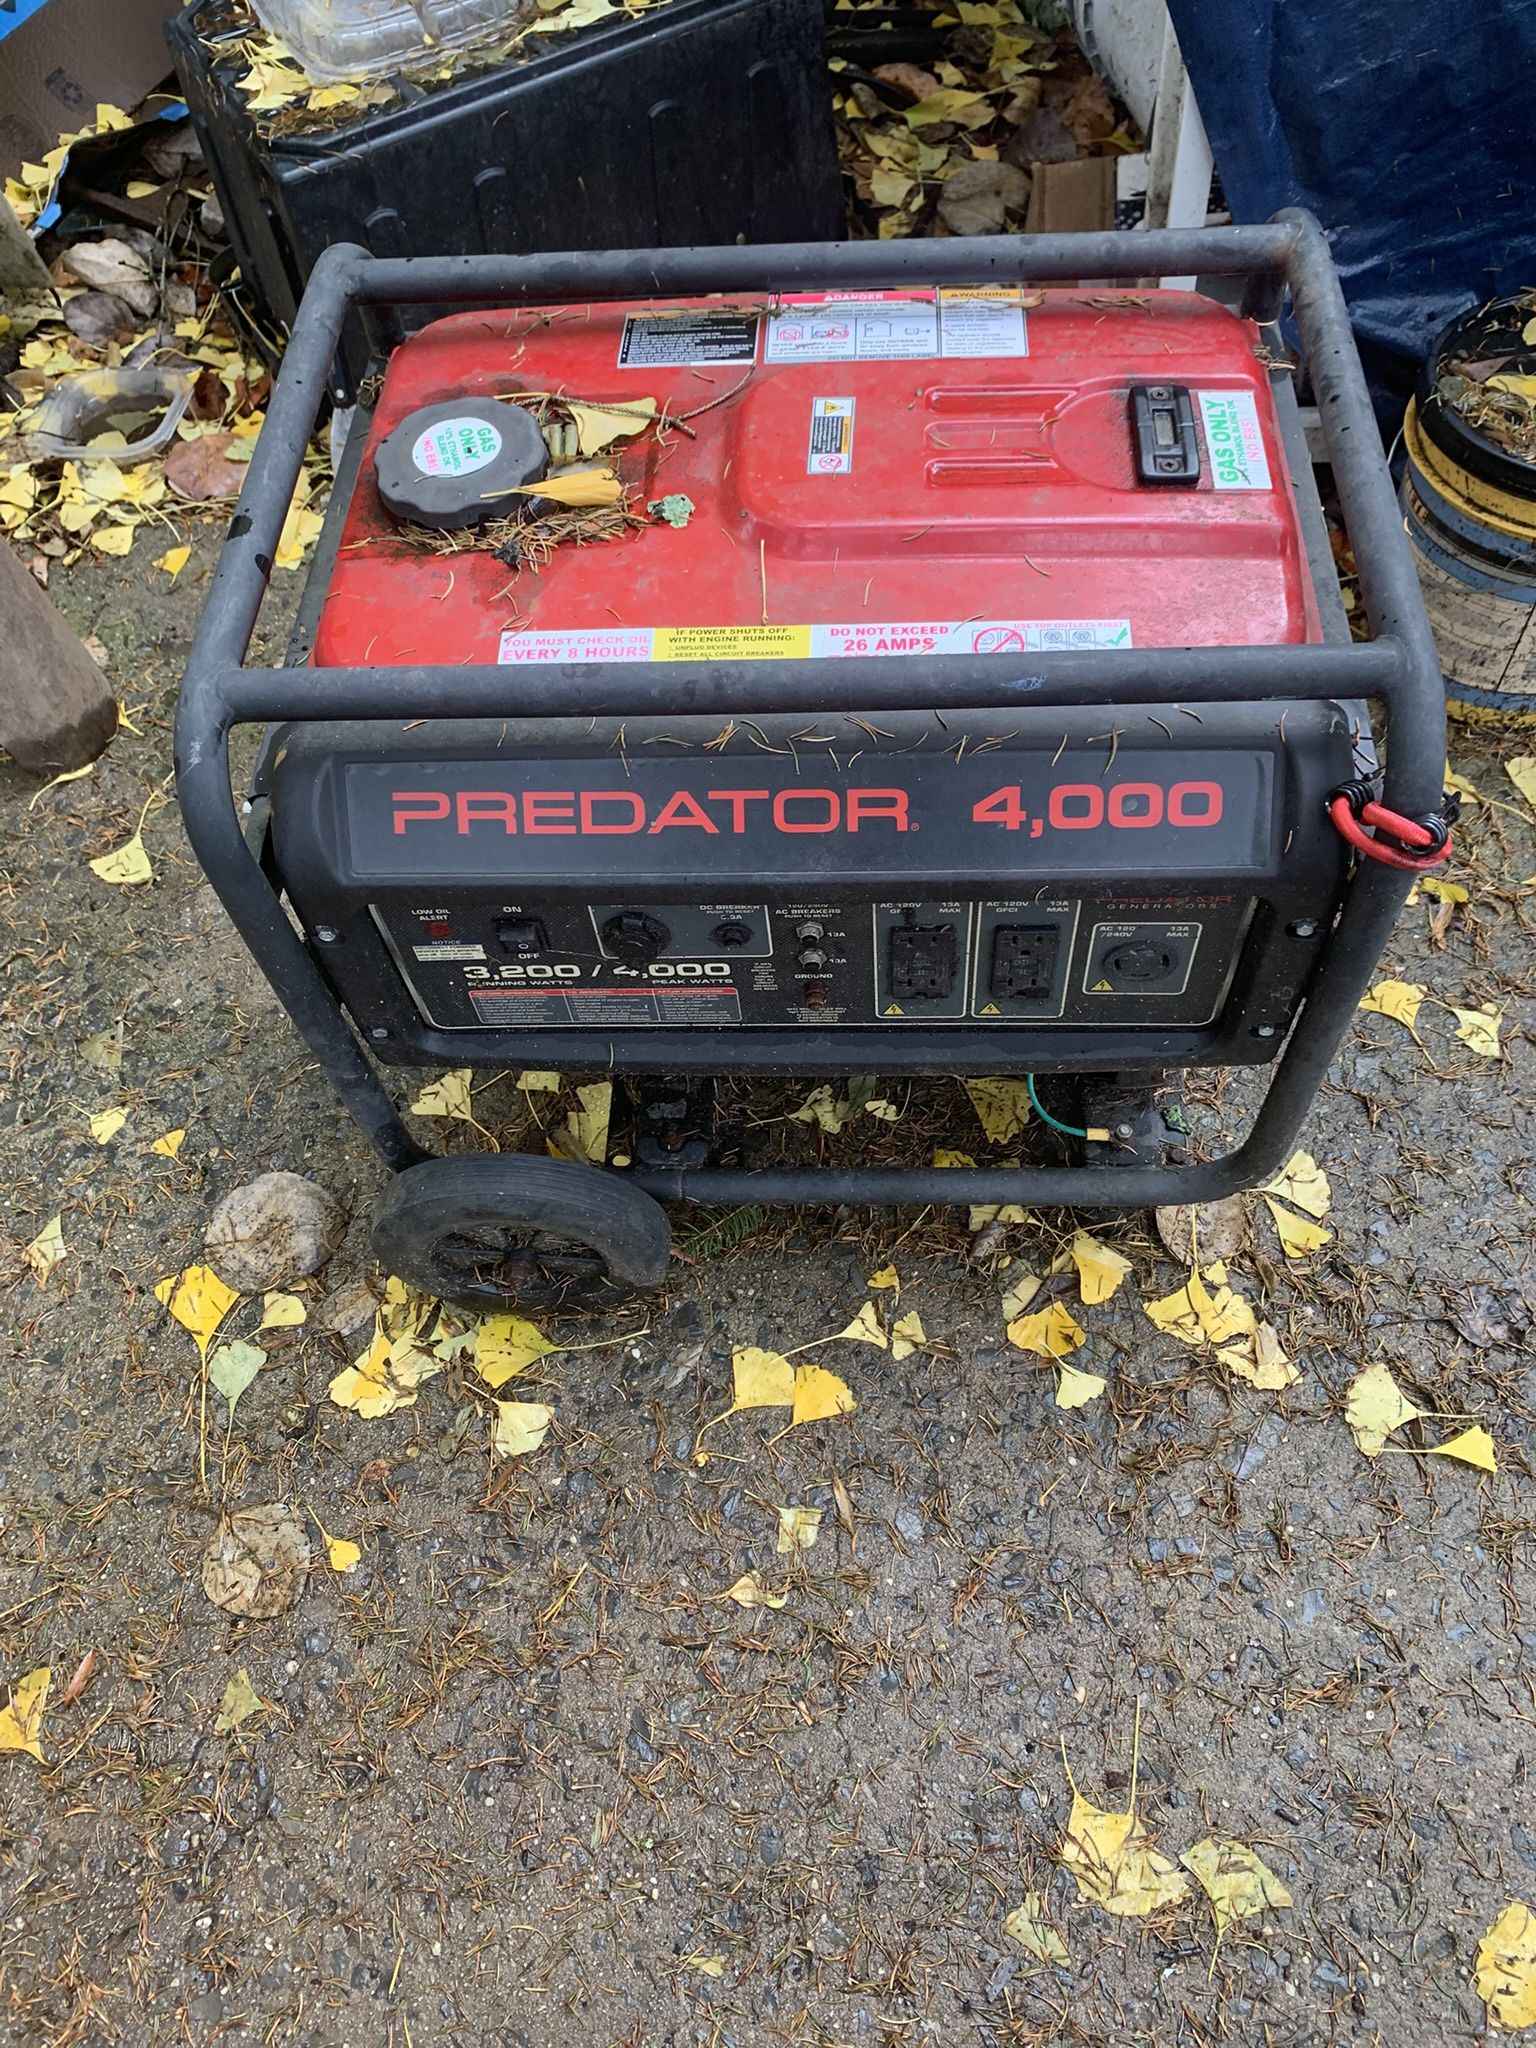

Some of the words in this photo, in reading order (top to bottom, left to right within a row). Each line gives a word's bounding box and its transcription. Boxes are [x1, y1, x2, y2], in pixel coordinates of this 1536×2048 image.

[834, 292, 884, 300] DANGER
[1205, 399, 1231, 443] ONLY
[437, 435, 447, 455] BLEND
[459, 428, 481, 459] ONLY
[477, 427, 496, 452] GAS
[1215, 448, 1240, 482] GAS
[699, 635, 740, 643] ENGINE
[830, 628, 850, 637] DO
[855, 627, 886, 636] NOT
[891, 626, 949, 636] EXCEED
[505, 639, 531, 648] YOU
[535, 637, 573, 645] MUST
[577, 636, 625, 645] CHECK
[628, 635, 651, 643] OIL
[843, 639, 868, 652] 26
[875, 637, 936, 651] AMPS
[502, 648, 561, 661] EVERY
[568, 647, 578, 660] 8
[585, 646, 649, 658] HOURS
[392, 788, 909, 835] PREDATOR
[972, 781, 1224, 838] 4,000
[518, 952, 540, 960] OFF
[462, 965, 581, 981] 3,200
[590, 963, 601, 978] /
[612, 962, 731, 979] 4,000
